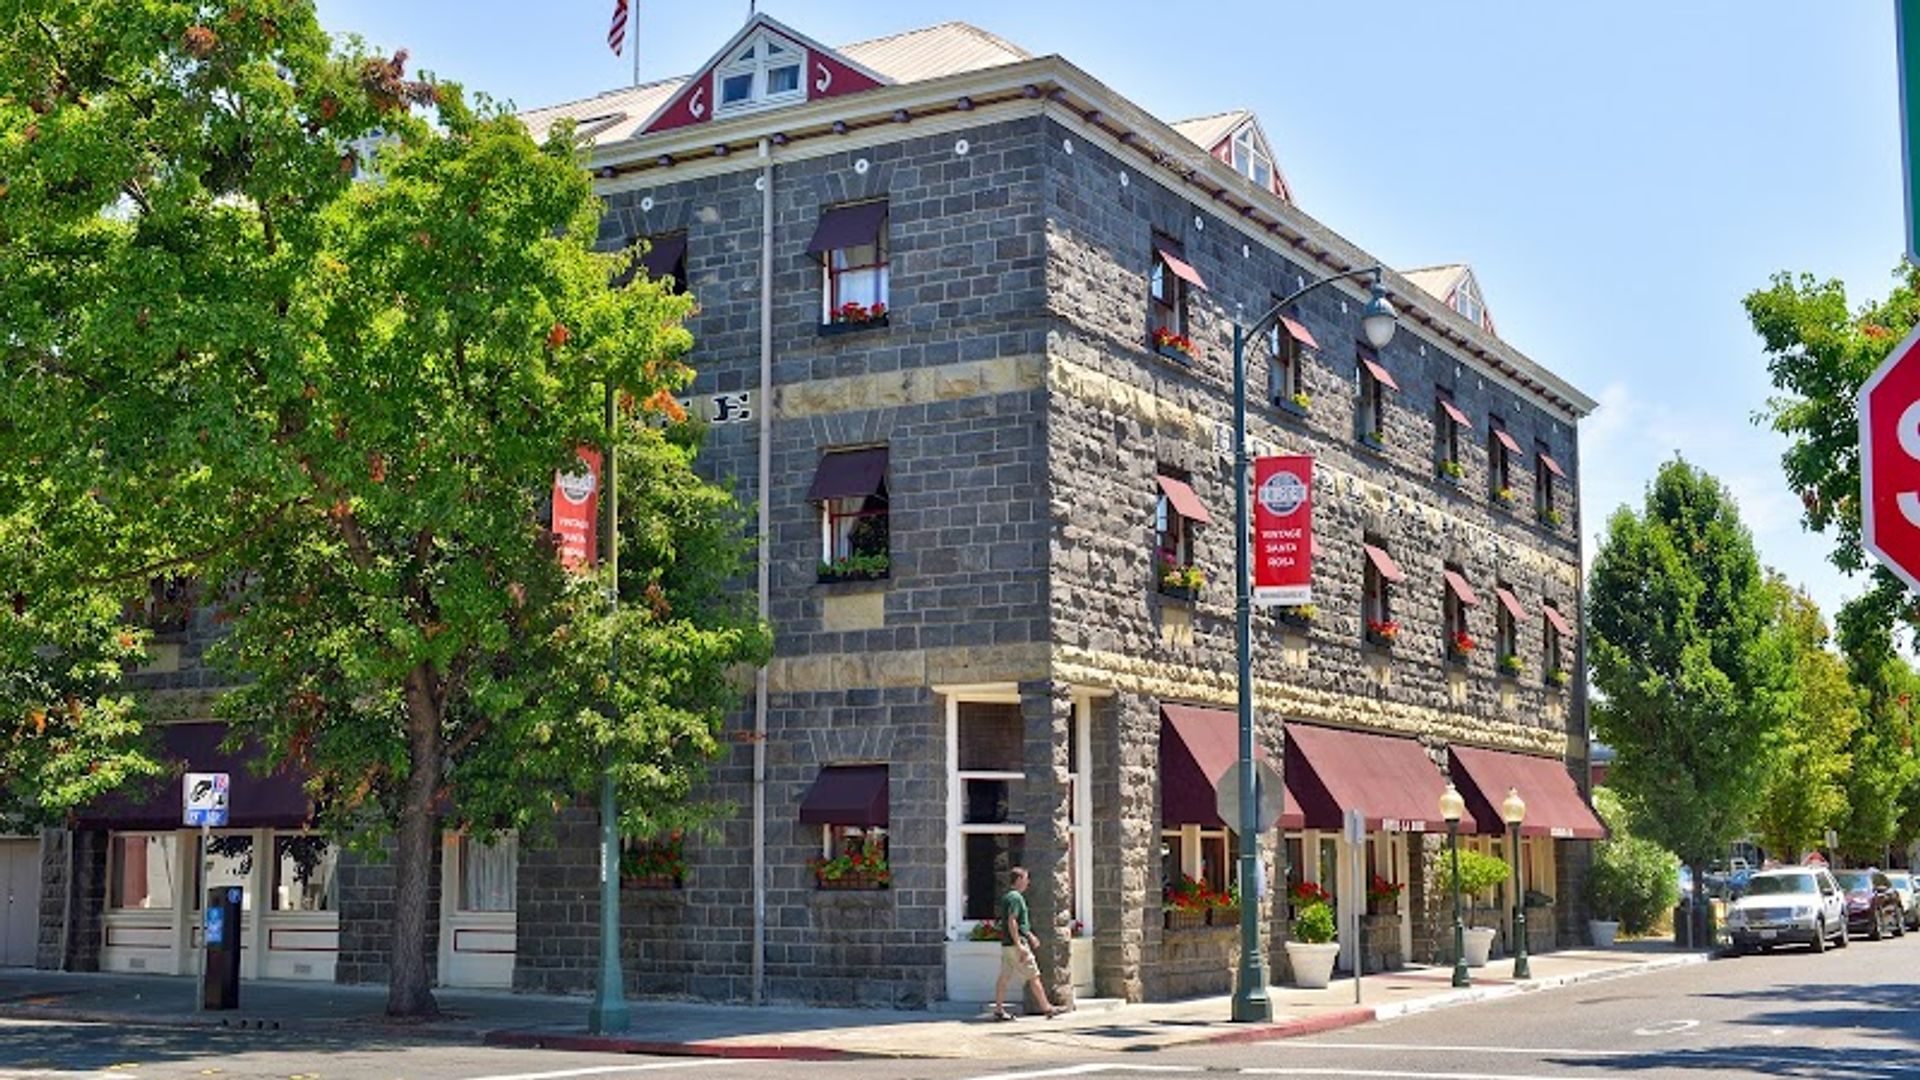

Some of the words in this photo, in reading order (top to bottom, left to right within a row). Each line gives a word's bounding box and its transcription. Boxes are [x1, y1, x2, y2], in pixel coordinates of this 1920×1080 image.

[1261, 528, 1302, 539] VINTAGE
[1265, 543, 1297, 553] SANTA
[1267, 557, 1295, 568] ROSA
